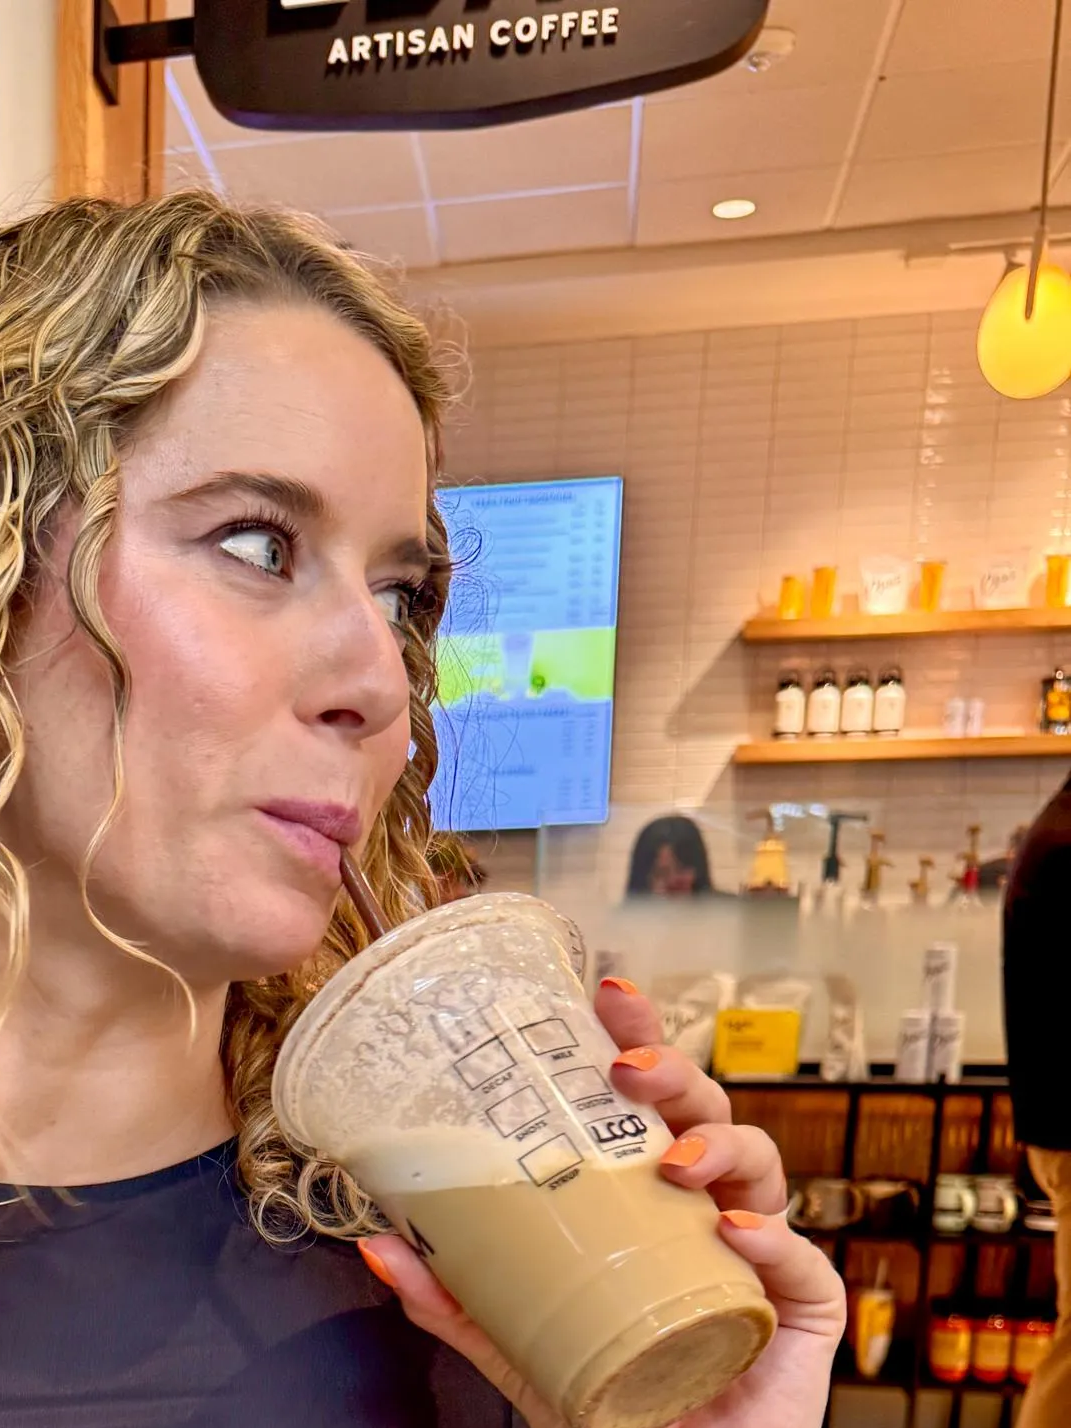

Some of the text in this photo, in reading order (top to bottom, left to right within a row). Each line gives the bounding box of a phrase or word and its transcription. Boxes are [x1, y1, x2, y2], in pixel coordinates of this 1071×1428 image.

[328, 7, 619, 64] ARTISAN COFFEE
[482, 1071, 512, 1094] DECAF
[515, 1120, 547, 1142] SHOTS
